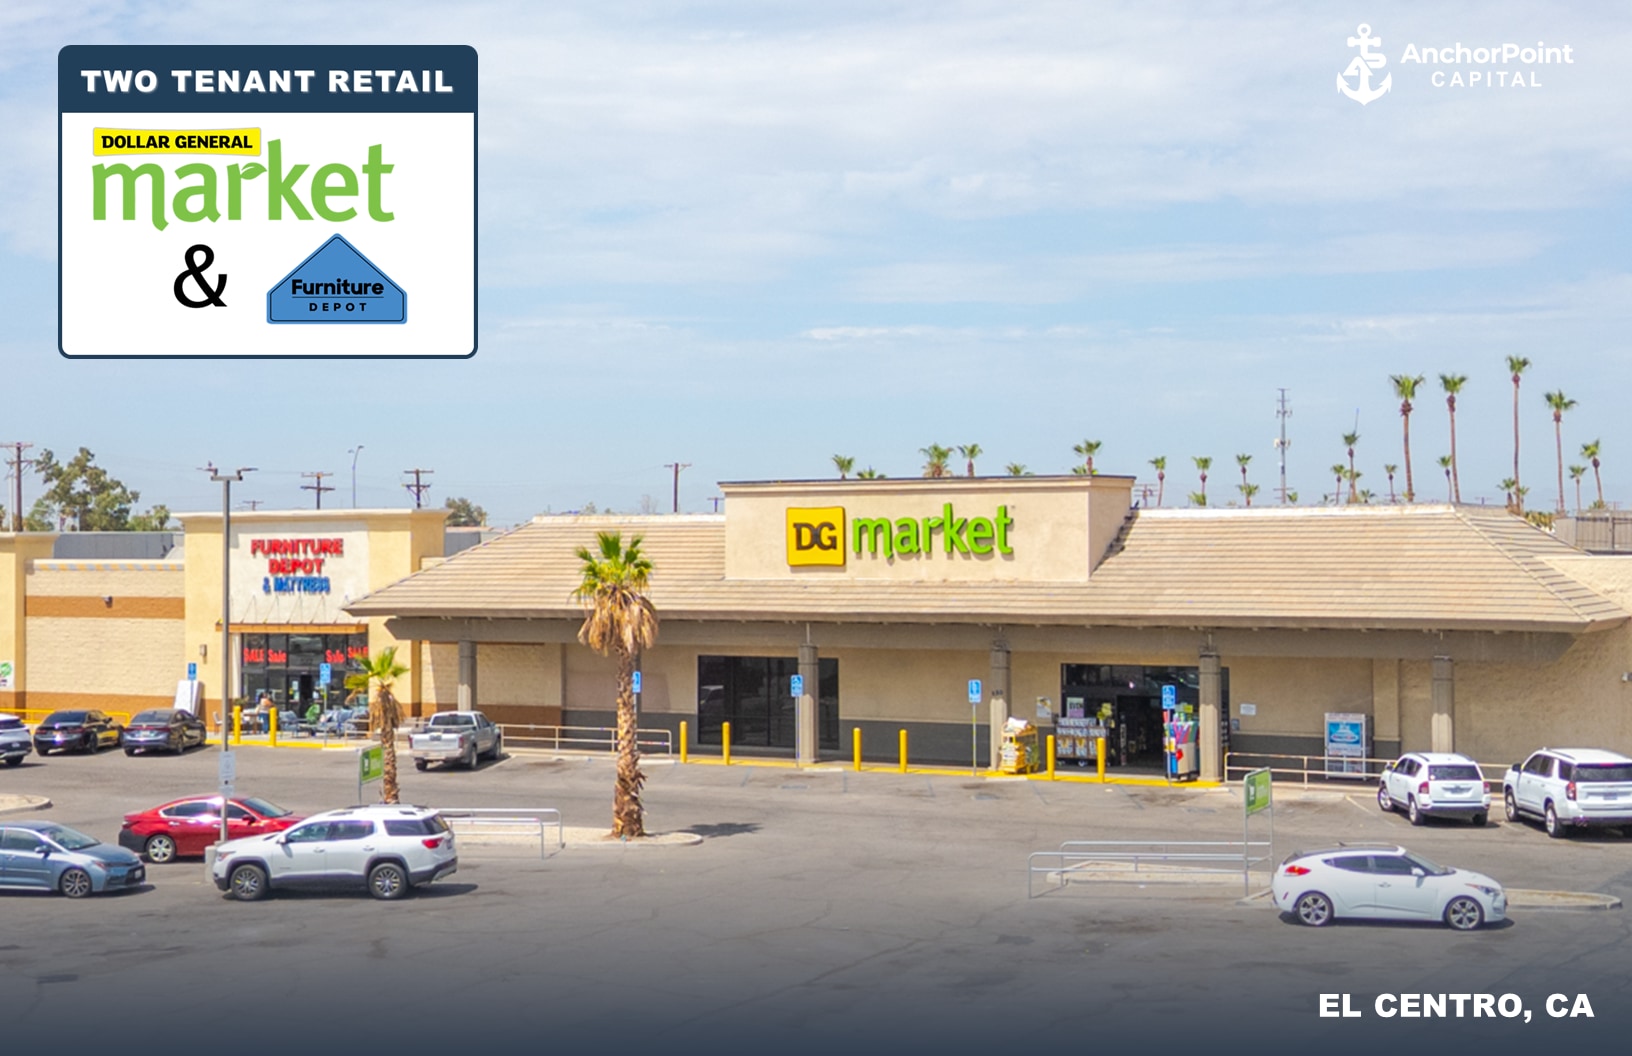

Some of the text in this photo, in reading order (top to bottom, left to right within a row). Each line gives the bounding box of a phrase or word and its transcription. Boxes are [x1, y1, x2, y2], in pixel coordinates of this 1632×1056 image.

[792, 502, 1013, 559] DG market
[251, 538, 344, 557] FURNITURE
[268, 558, 325, 575] DEPOT
[243, 647, 265, 663] SALE
